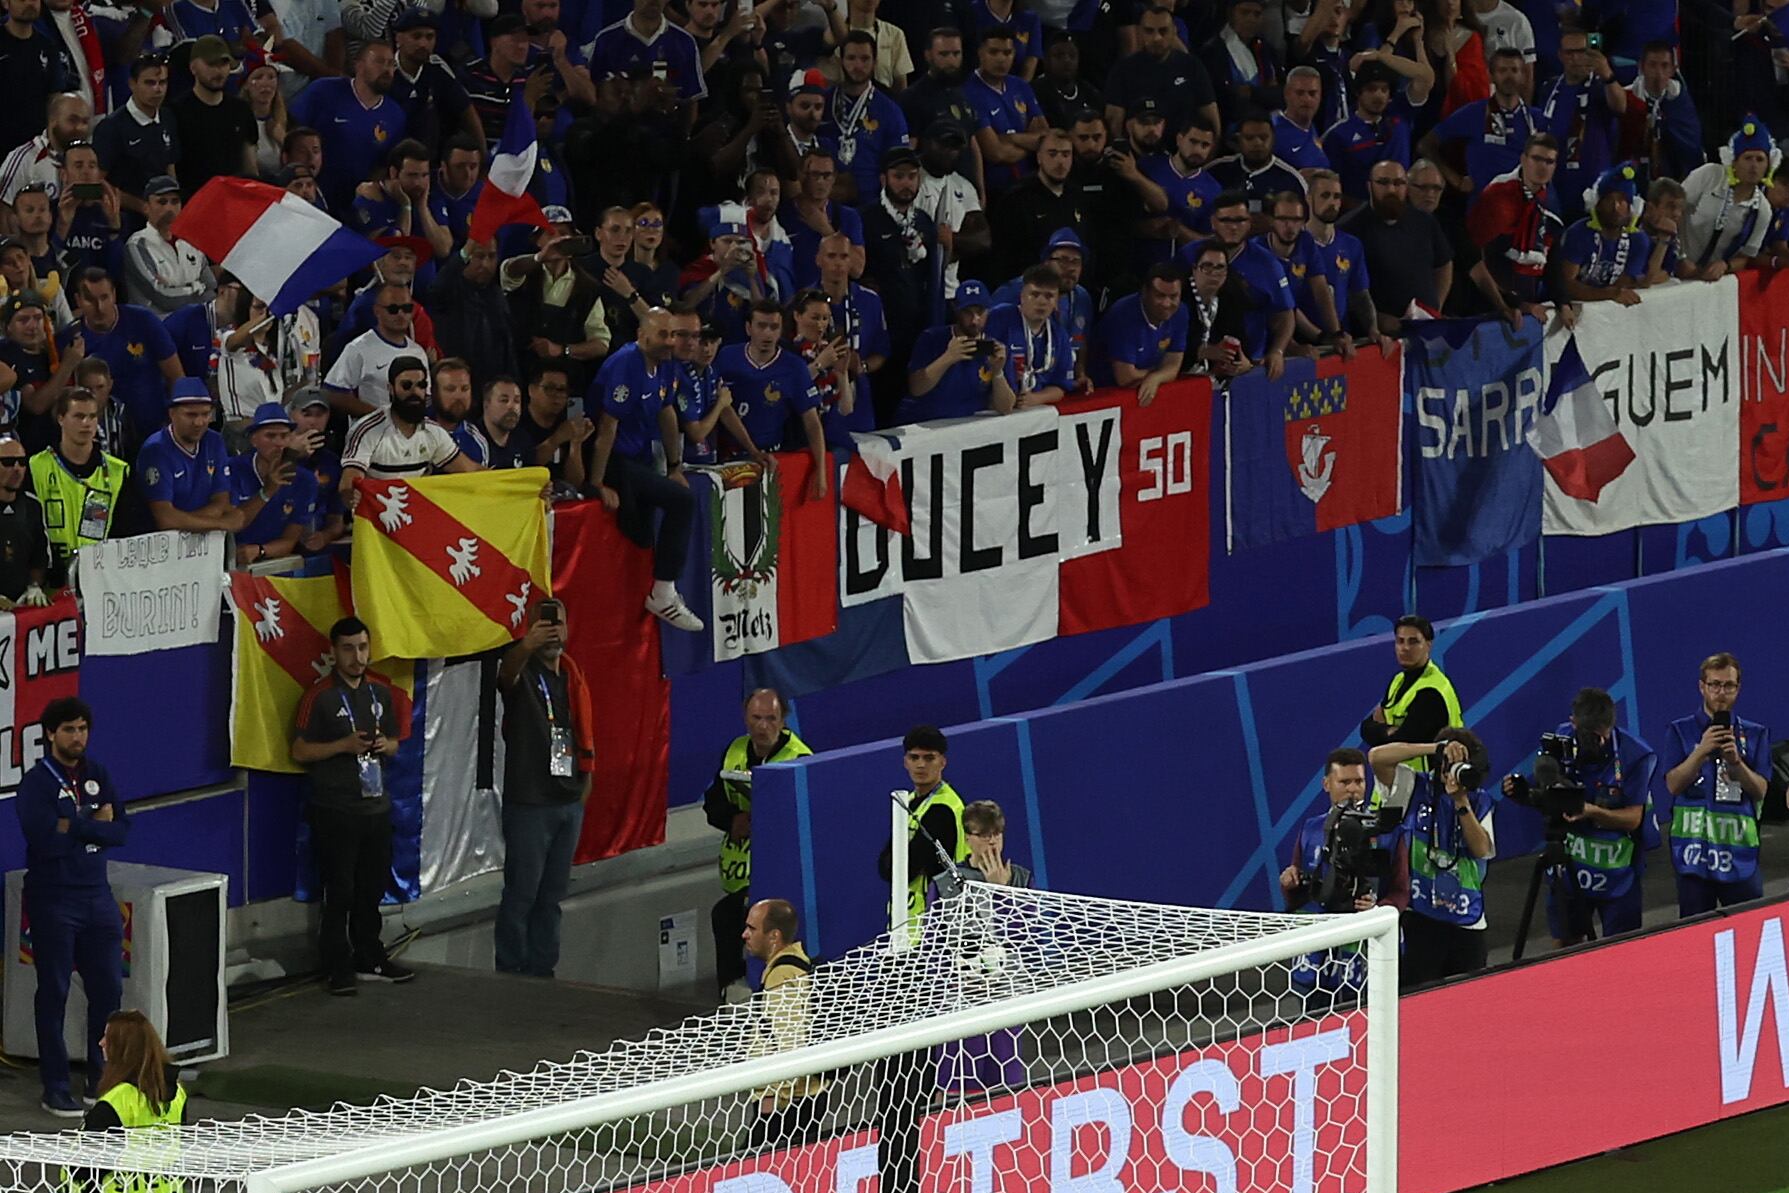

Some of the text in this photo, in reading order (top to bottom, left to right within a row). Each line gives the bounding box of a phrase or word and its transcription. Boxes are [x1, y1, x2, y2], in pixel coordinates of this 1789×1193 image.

[102, 580, 200, 639] BURIN!
[719, 606, 773, 651] Metz
[27, 619, 80, 681] ME
[1591, 841, 1623, 865] TV
